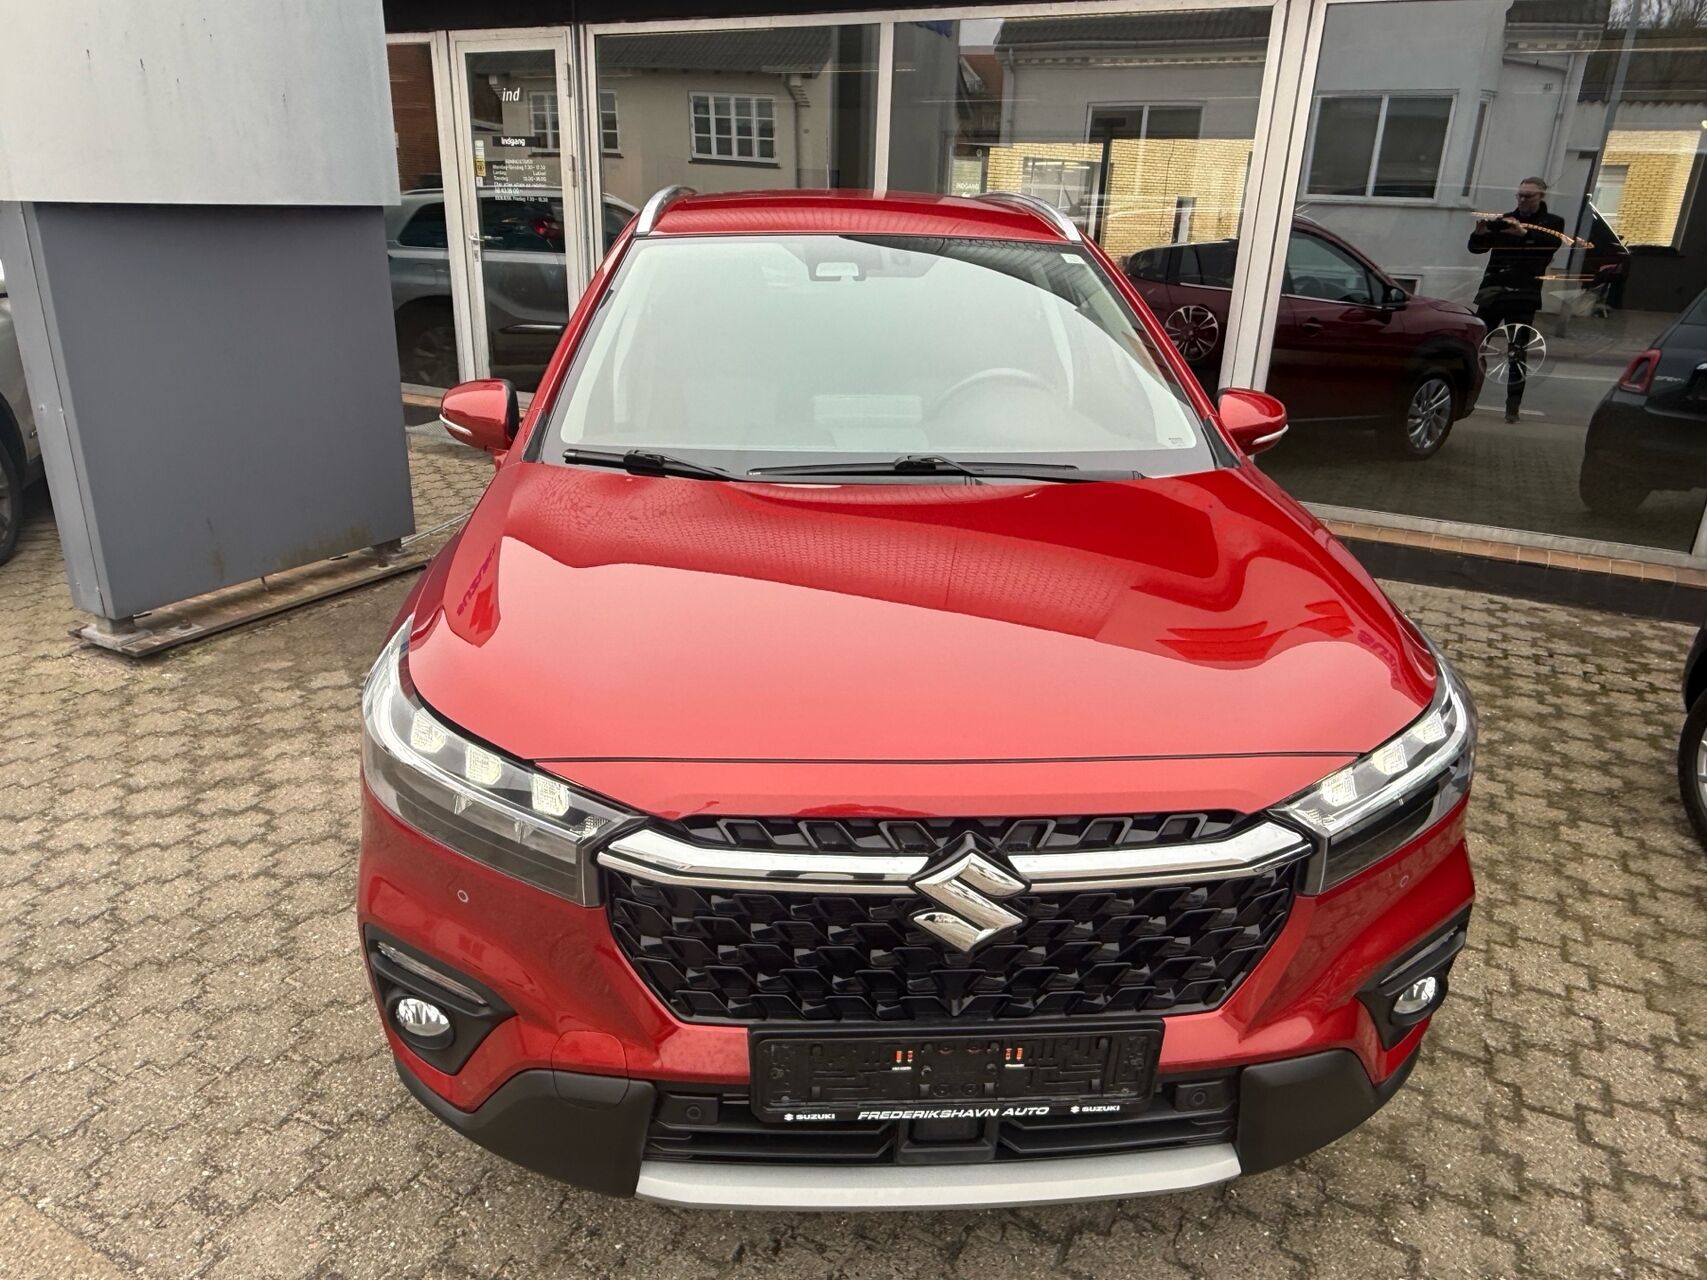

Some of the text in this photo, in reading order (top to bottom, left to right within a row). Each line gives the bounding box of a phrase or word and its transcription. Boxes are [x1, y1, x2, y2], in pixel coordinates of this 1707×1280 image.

[502, 88, 520, 101] ind
[501, 137, 525, 146] Indgang
[857, 1107, 1050, 1120] FREDERIKSHAVN AUTO
